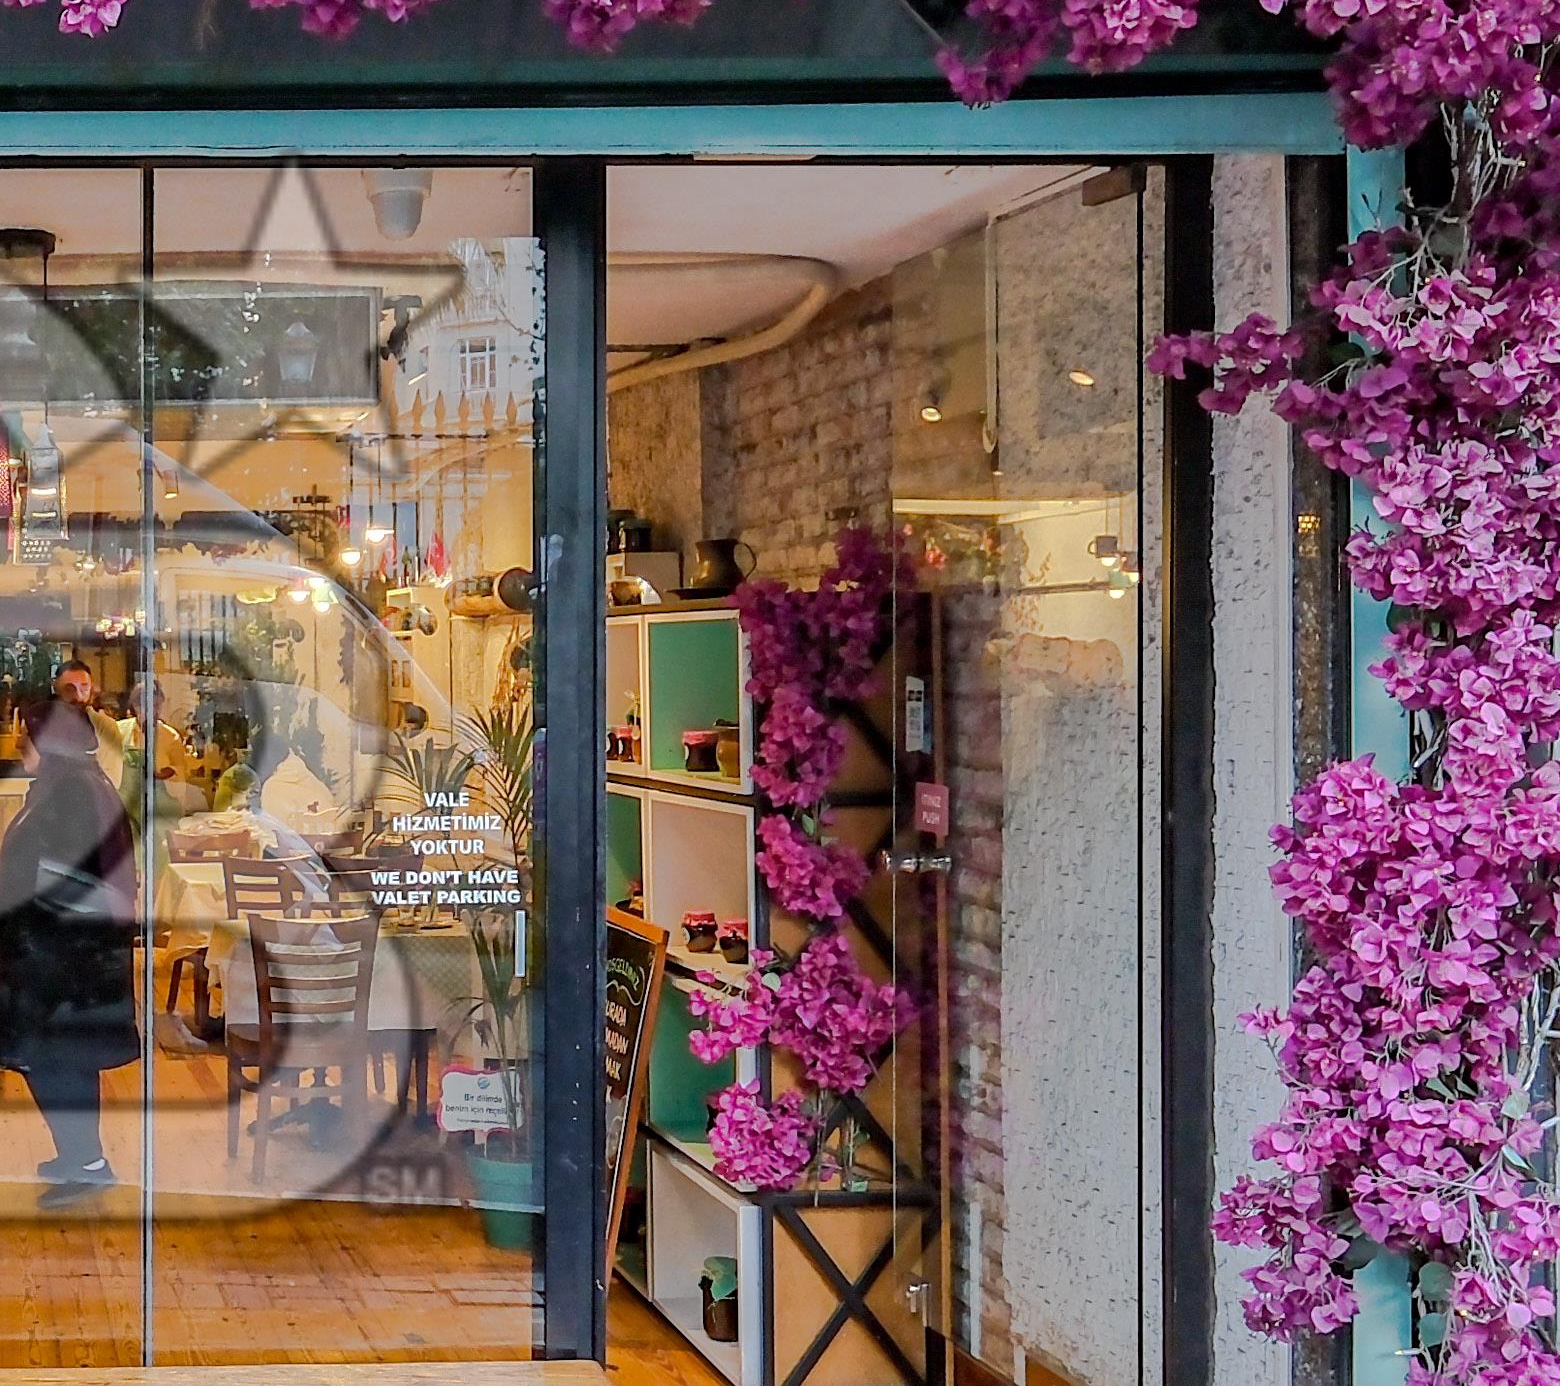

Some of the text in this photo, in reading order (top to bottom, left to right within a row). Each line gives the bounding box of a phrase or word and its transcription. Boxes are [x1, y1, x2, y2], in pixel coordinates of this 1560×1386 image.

[423, 791, 470, 807] VALE
[392, 813, 502, 832] HİZMETİMİZ
[410, 839, 485, 856] YOKTUR
[370, 869, 519, 885] WE DON'T HAVE
[371, 889, 522, 905] VALET PARKING
